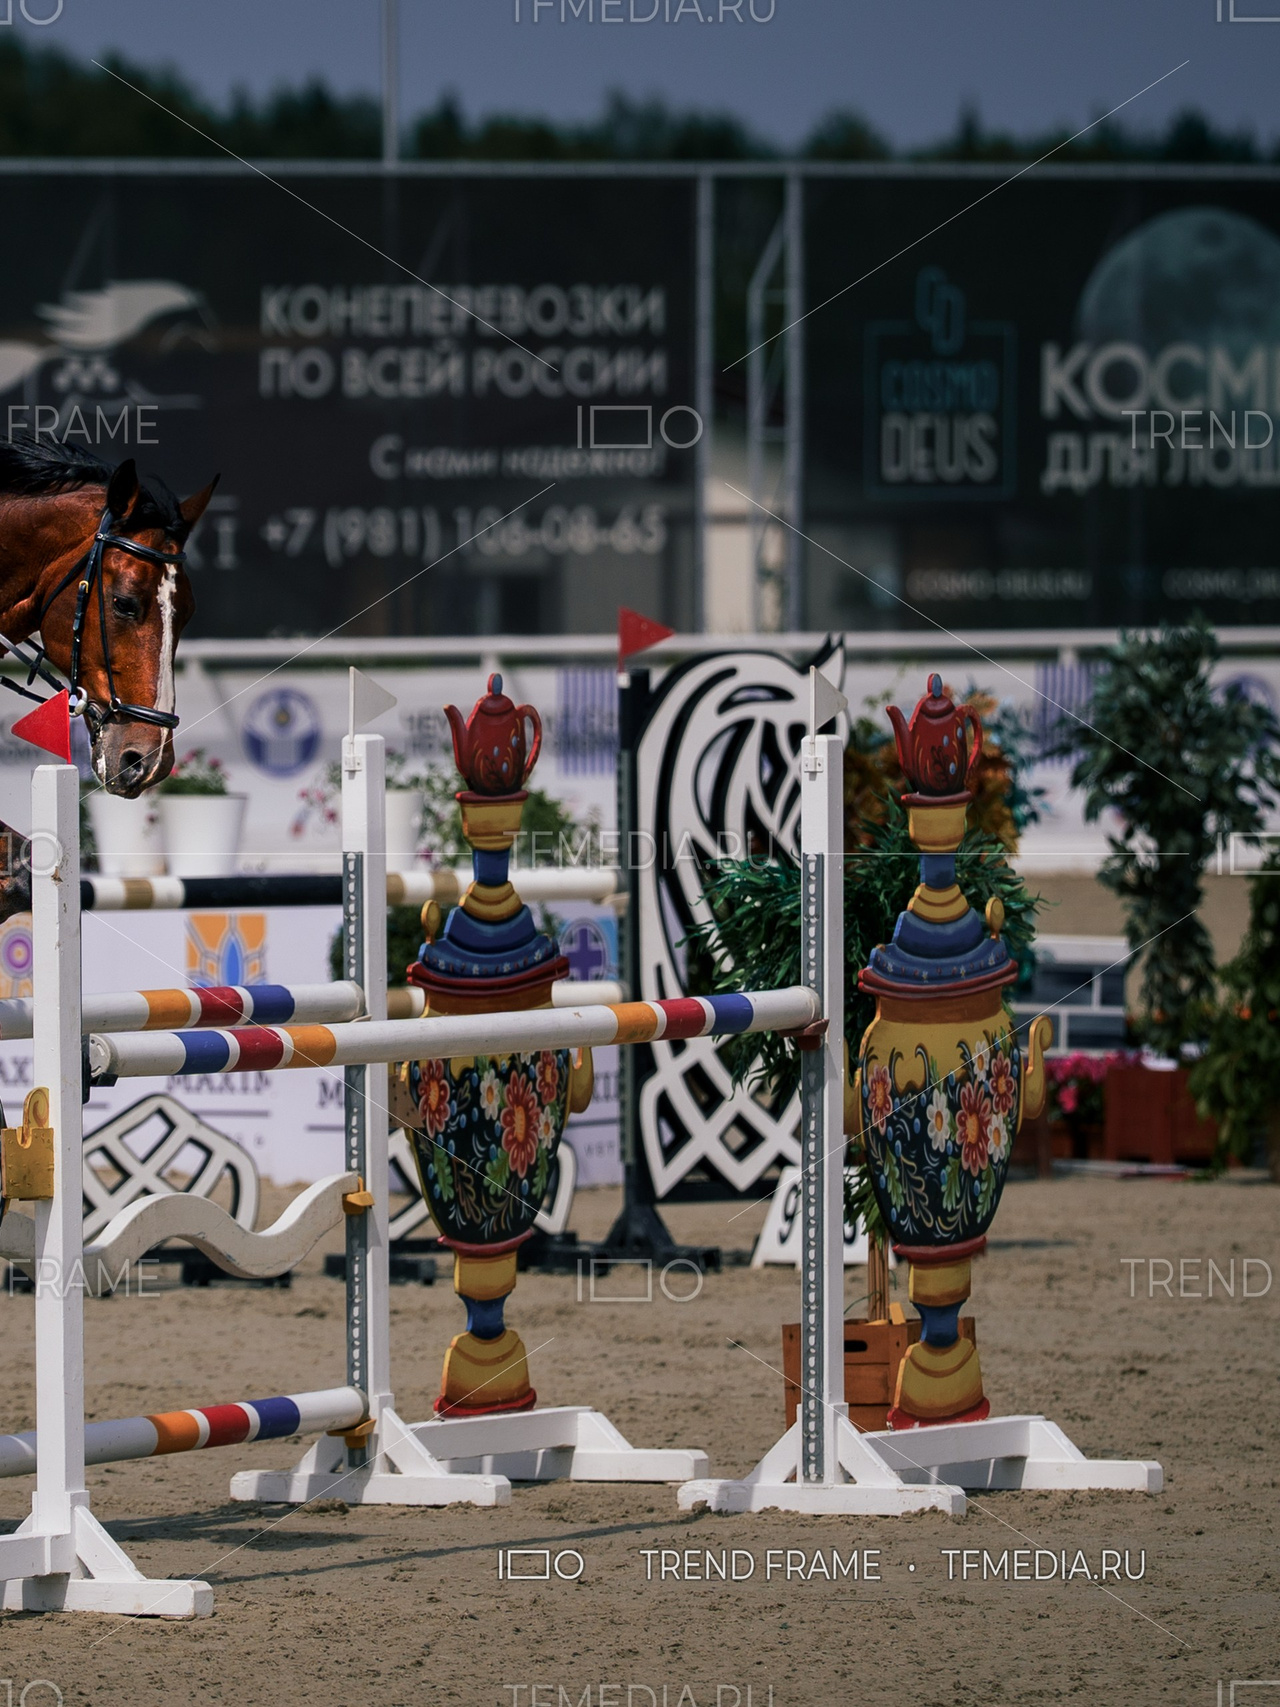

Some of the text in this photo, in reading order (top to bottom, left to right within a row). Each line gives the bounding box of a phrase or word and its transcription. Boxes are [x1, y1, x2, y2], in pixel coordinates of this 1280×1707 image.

[260, 284, 666, 337] КОНЕПЕРЕВОЗКИ
[260, 337, 666, 399] ПО ВСЕЙ РОССИИ
[1039, 341, 1280, 420] КОСМ
[880, 412, 999, 484] DEUS
[1039, 432, 1158, 496] ДЛЯ
[261, 506, 317, 558] +7
[324, 506, 443, 568] (981)
